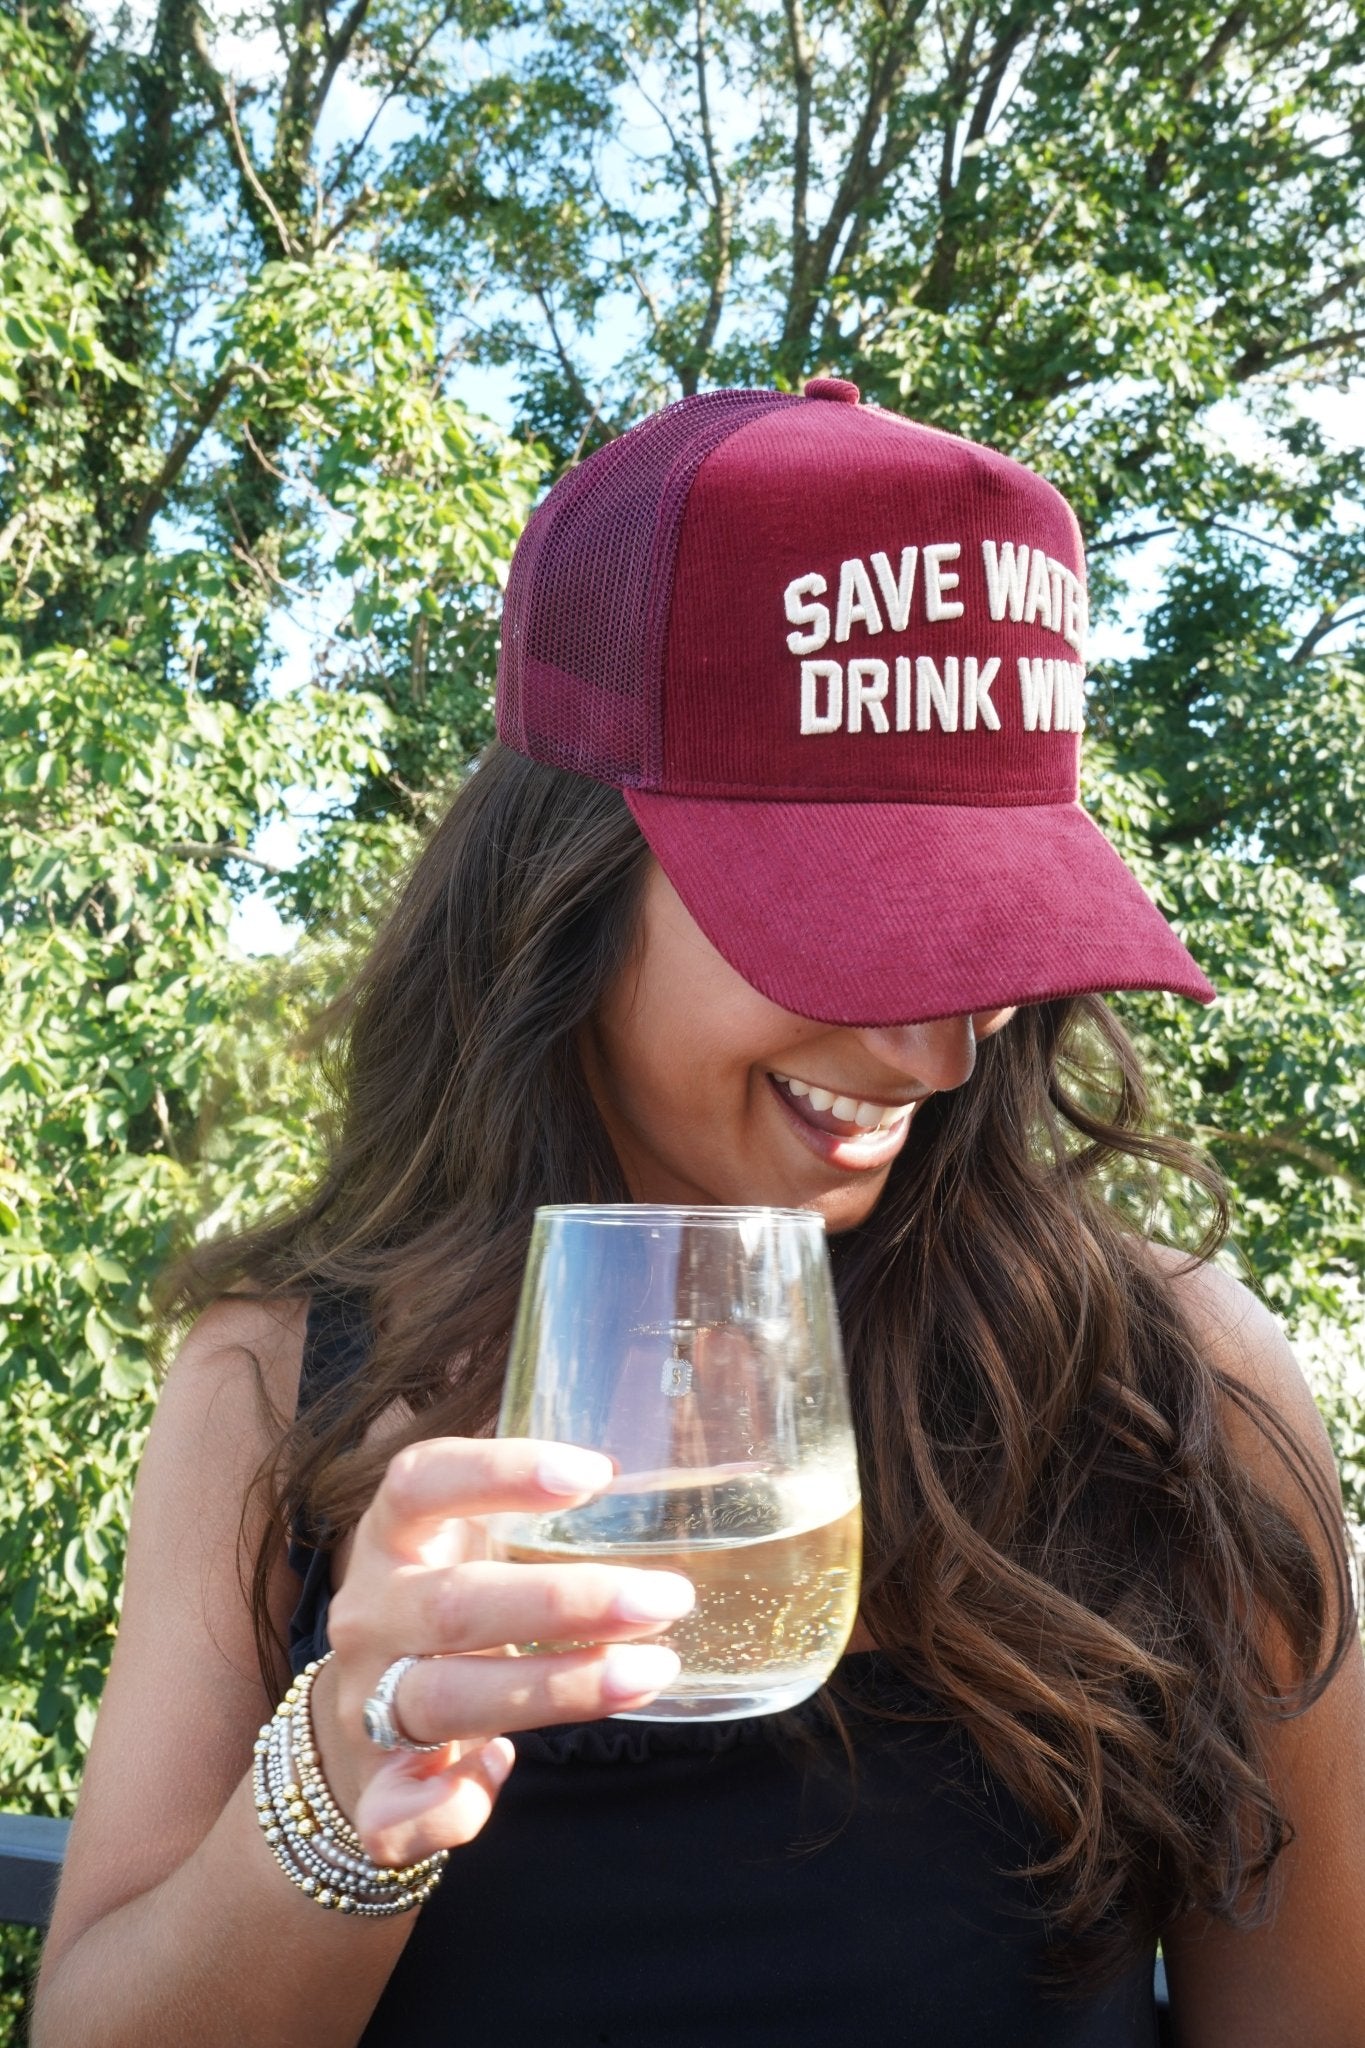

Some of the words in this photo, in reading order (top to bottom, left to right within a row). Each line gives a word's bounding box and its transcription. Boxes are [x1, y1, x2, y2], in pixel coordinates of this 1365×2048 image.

[784, 542, 964, 655] SAVE
[982, 540, 1089, 652] WATE
[800, 656, 1001, 735] DRINK
